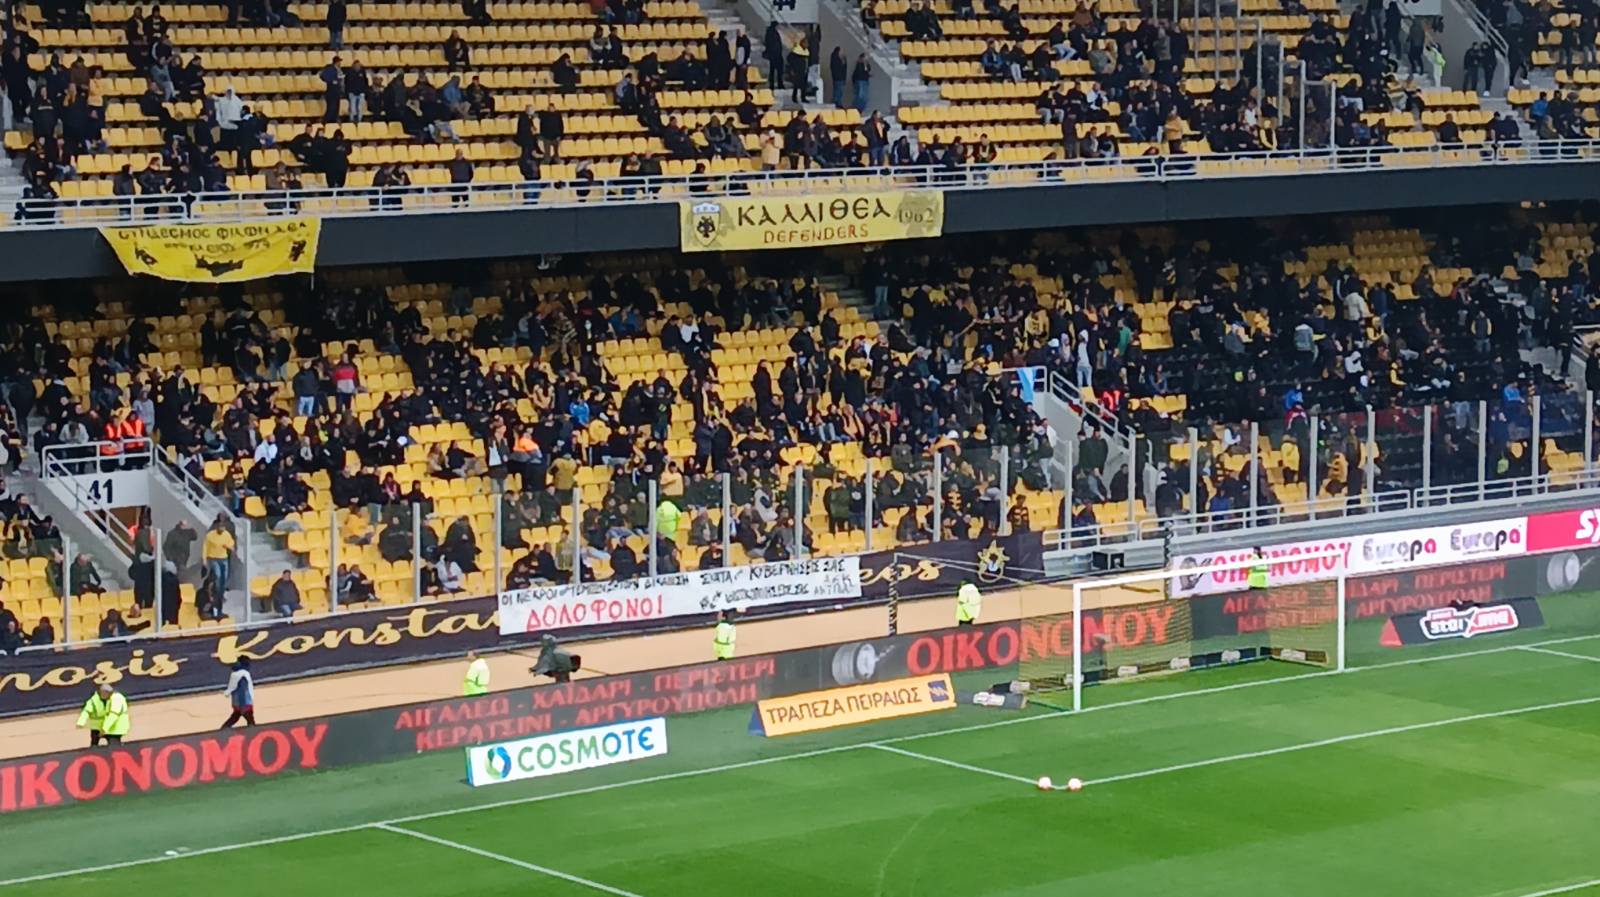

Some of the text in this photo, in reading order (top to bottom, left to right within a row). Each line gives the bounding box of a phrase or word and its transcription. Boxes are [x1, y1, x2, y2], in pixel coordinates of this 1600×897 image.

[764, 223, 870, 244] DEFENDERS
[87, 478, 113, 505] 41
[1363, 527, 1521, 561] Europa Europa
[906, 605, 1174, 677] ΟΙΚΟΝΟΜΟΥ
[654, 658, 776, 692] ΠΕΡΙΣΤΕΡΙ
[767, 686, 922, 725] ΤΡΑΠΕΖΑ ΠΕΙΡΑΙΩΣ
[416, 713, 552, 750] ΚΕΡΑΤΣΙΝΙ
[517, 726, 655, 773] COSMOTE
